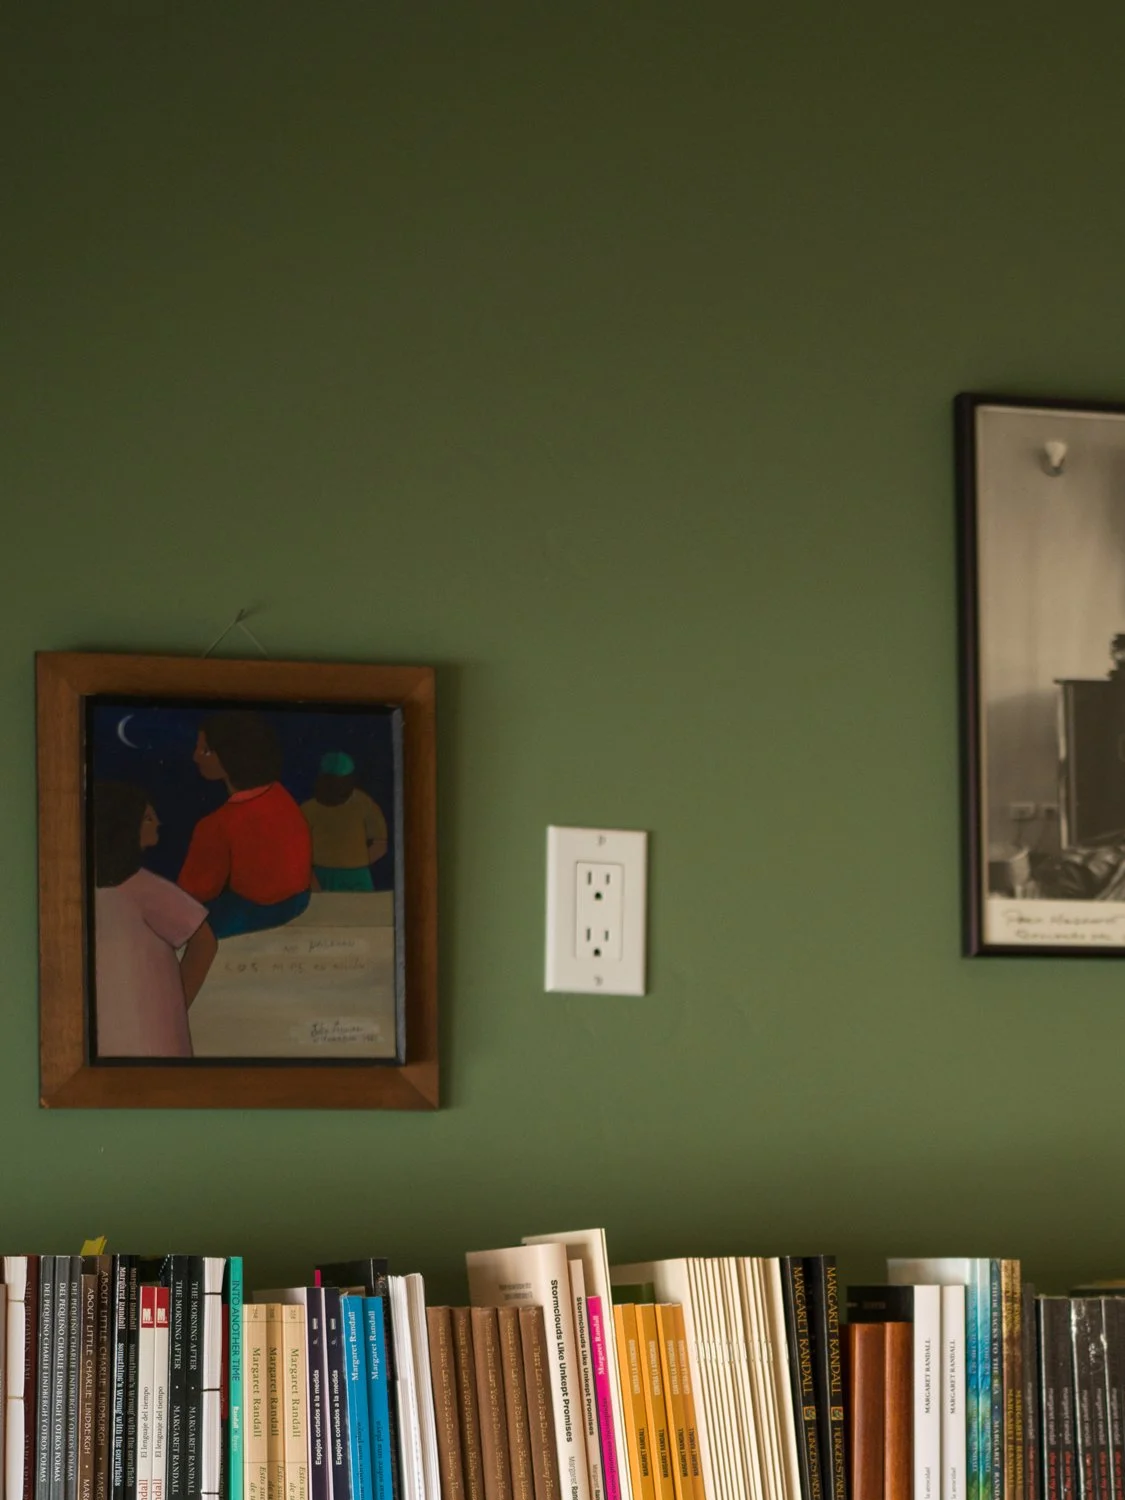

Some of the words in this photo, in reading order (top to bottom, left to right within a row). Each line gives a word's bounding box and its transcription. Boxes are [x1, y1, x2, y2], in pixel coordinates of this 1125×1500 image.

[87, 1287, 95, 1320] ABOUT
[175, 1281, 183, 1297] THE
[231, 1280, 240, 1305] INTO
[793, 1266, 809, 1332] MARGARET
[175, 1299, 183, 1341] MORNING
[551, 1279, 563, 1340] Stormclouds
[86, 1325, 94, 1355] LITTLE
[231, 1306, 240, 1357] ANOTHER
[557, 1342, 565, 1361] Like
[85, 1359, 93, 1398] CHARLIE
[231, 1359, 240, 1381] TIME
[252, 1347, 261, 1394] Margaret
[559, 1362, 569, 1397] Unkept
[799, 1339, 814, 1395] RANDALL
[83, 1402, 92, 1455] LINDBERGH
[141, 1422, 149, 1450] lenguaje
[172, 1406, 180, 1451] MARGARET
[253, 1398, 262, 1438] Randall
[563, 1398, 572, 1443] Promises
[171, 1453, 179, 1494] RANDALL
[568, 1456, 577, 1483] Margaret
